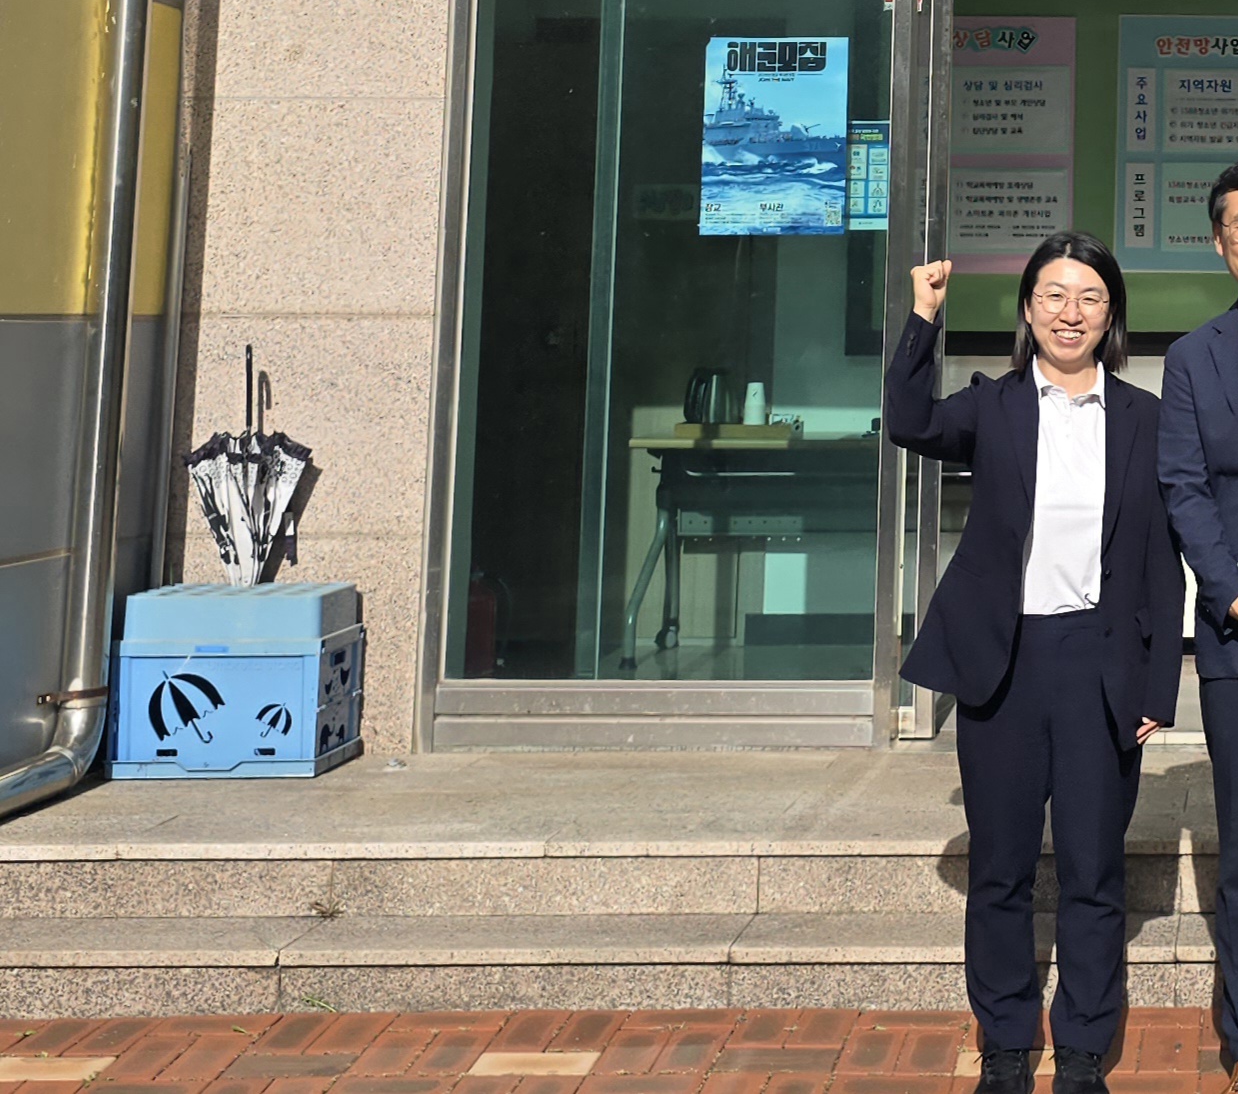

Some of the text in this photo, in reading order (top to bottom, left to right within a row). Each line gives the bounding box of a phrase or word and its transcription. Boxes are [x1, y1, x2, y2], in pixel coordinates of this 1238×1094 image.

[727, 41, 827, 72] 해군모집
[963, 80, 1043, 92] 상담 및 심리검사
[1179, 79, 1232, 93] 지역자원
[1134, 77, 1148, 140] 주요사업
[1133, 174, 1146, 237] 프로그램
